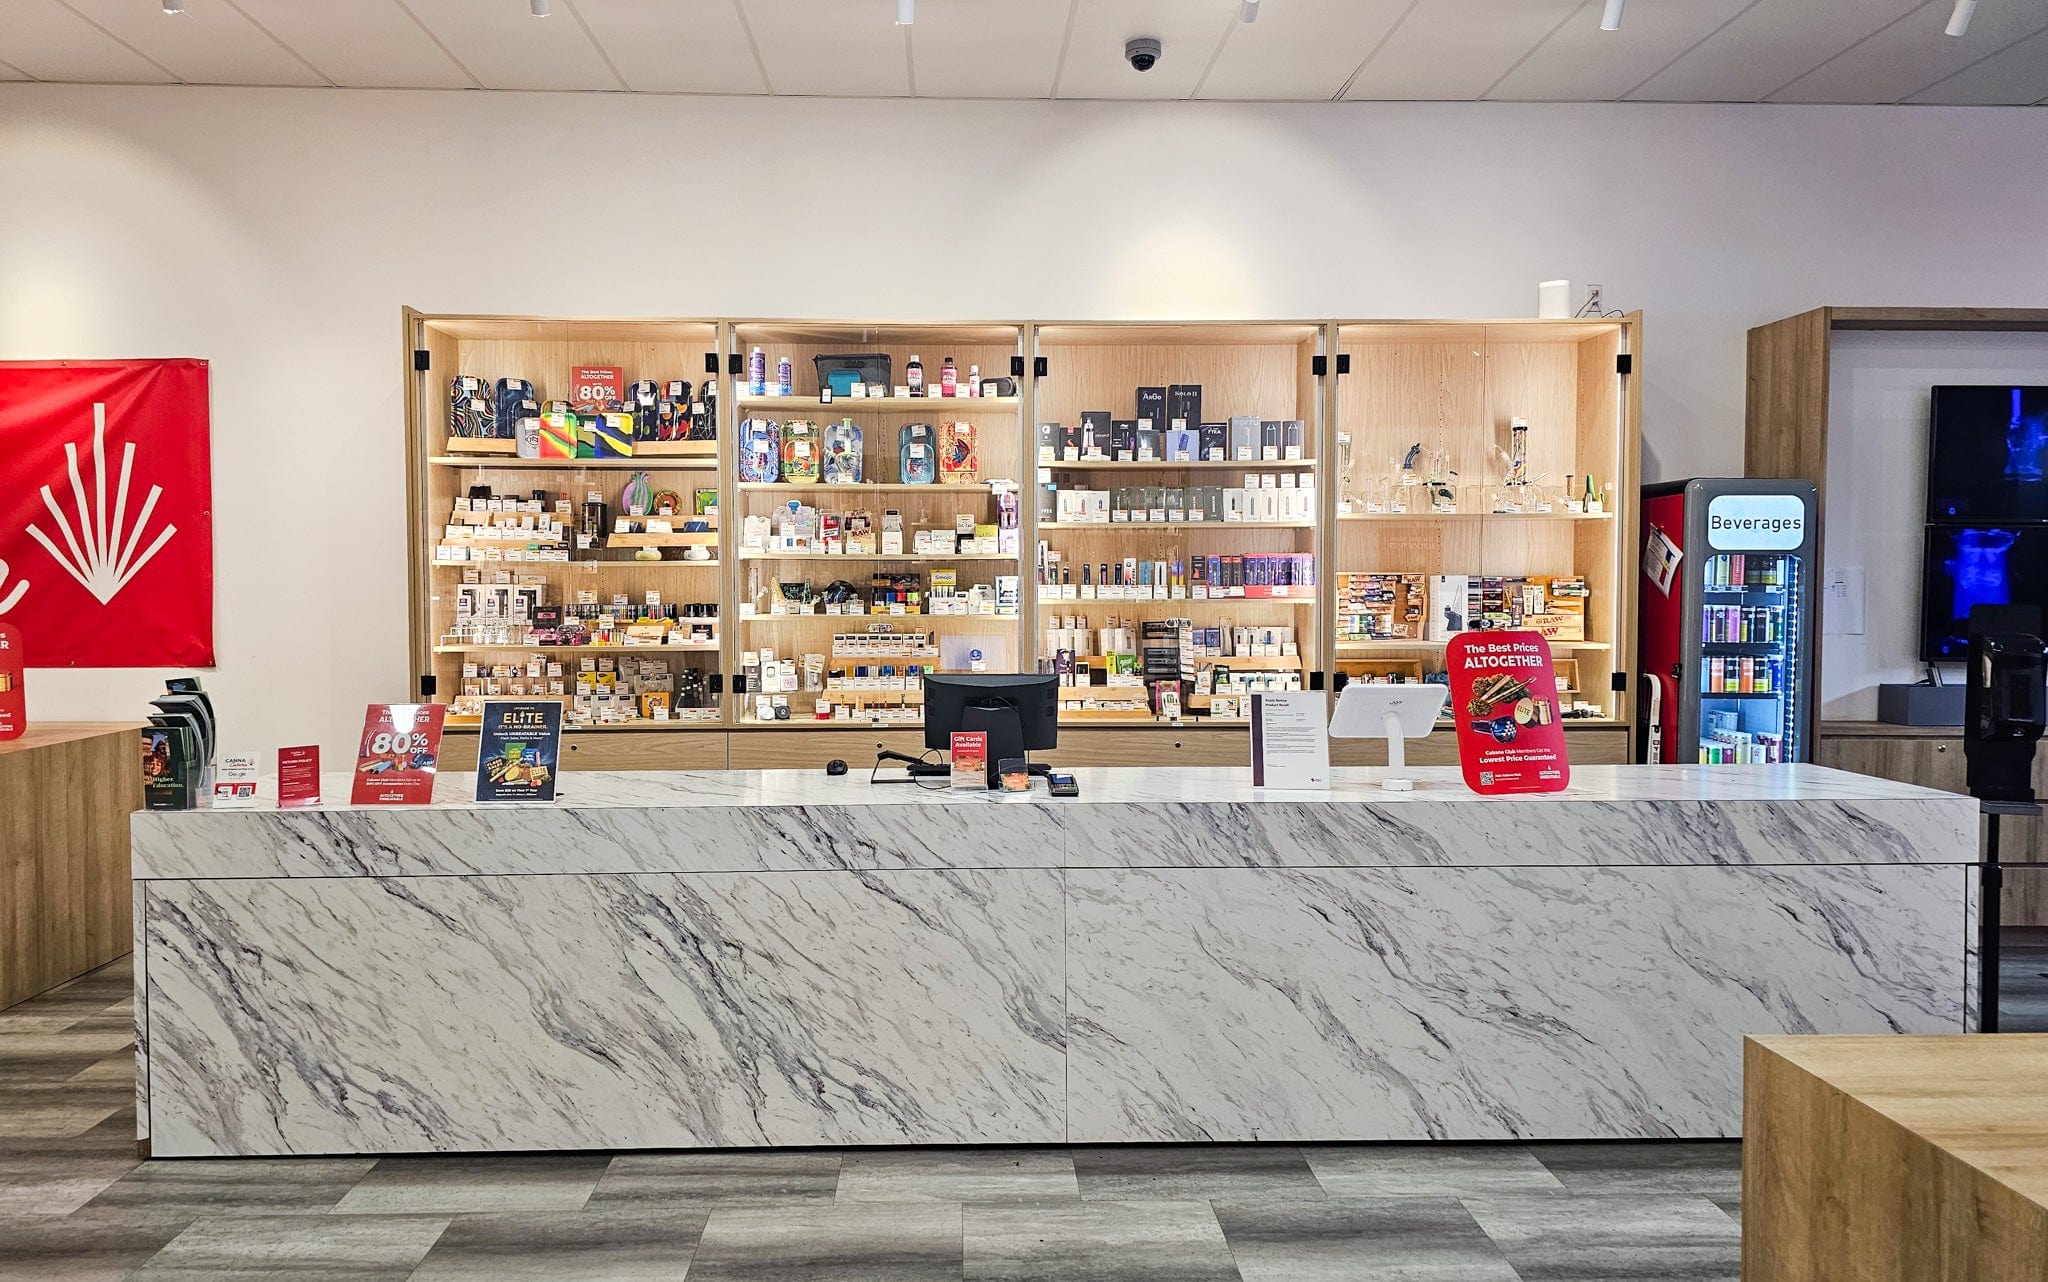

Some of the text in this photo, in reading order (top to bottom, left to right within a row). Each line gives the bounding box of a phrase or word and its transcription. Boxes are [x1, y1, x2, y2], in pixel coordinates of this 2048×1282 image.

[580, 385, 616, 400] 80%
[1711, 515, 1801, 533] Beverages
[851, 529, 870, 537] RAW
[1542, 616, 1564, 624] RAW
[1541, 627, 1559, 636] AW
[1464, 642, 1539, 654] The Best Prices
[1464, 655, 1543, 669] ALTOGETHER
[1517, 704, 1530, 716] ELITE
[372, 732, 428, 754] 80%
